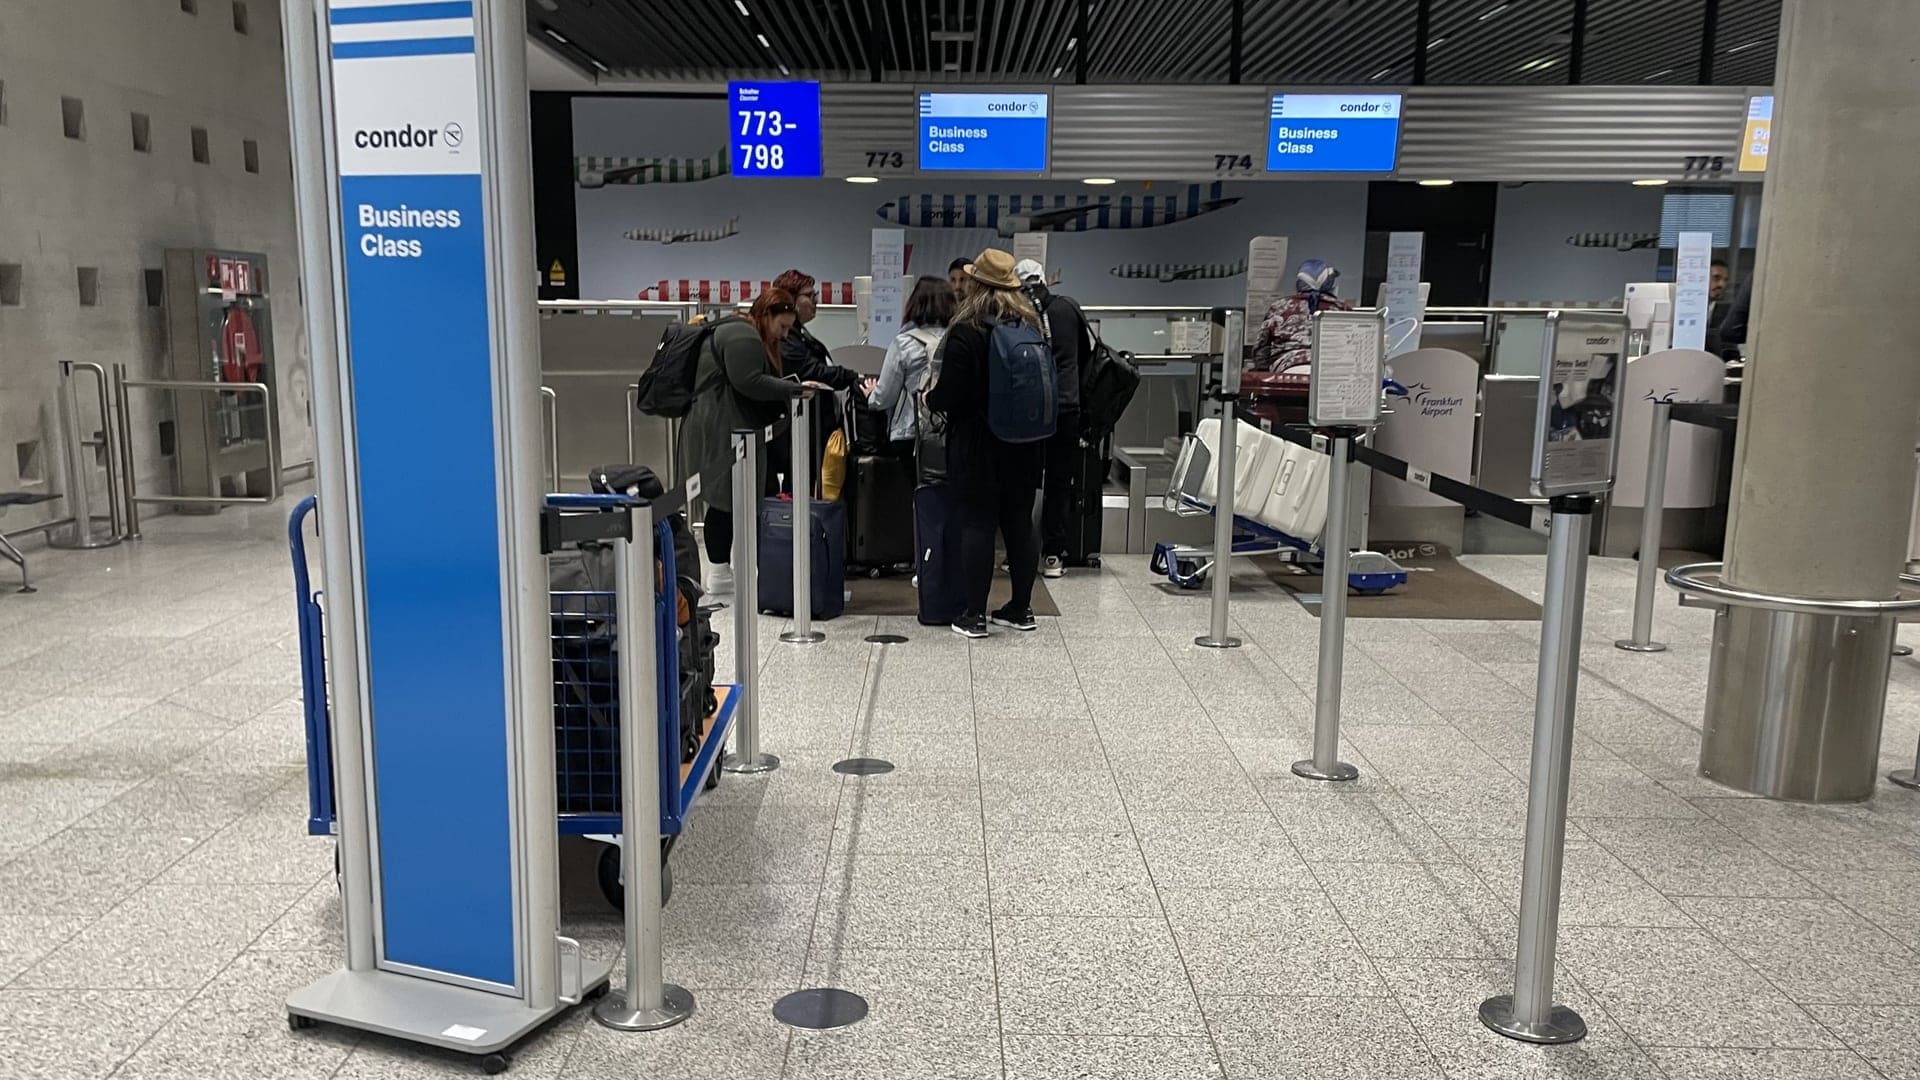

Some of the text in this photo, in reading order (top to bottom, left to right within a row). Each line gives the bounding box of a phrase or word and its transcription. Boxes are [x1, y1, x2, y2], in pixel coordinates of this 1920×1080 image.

[988, 102, 1027, 112] condor
[1340, 102, 1380, 112] condor
[738, 110, 797, 136] 773-
[354, 124, 438, 149] condor
[928, 126, 988, 138] Business
[1278, 127, 1338, 139] Business
[928, 141, 965, 153] Class
[1278, 142, 1314, 154] Class
[740, 144, 784, 170] 798
[865, 152, 904, 168] 773
[1214, 154, 1253, 170] 774
[1684, 156, 1723, 171] 775
[358, 204, 461, 228] Business
[360, 233, 422, 257] Class
[1421, 397, 1463, 406] Frankfurt
[1421, 408, 1453, 418] Airport
